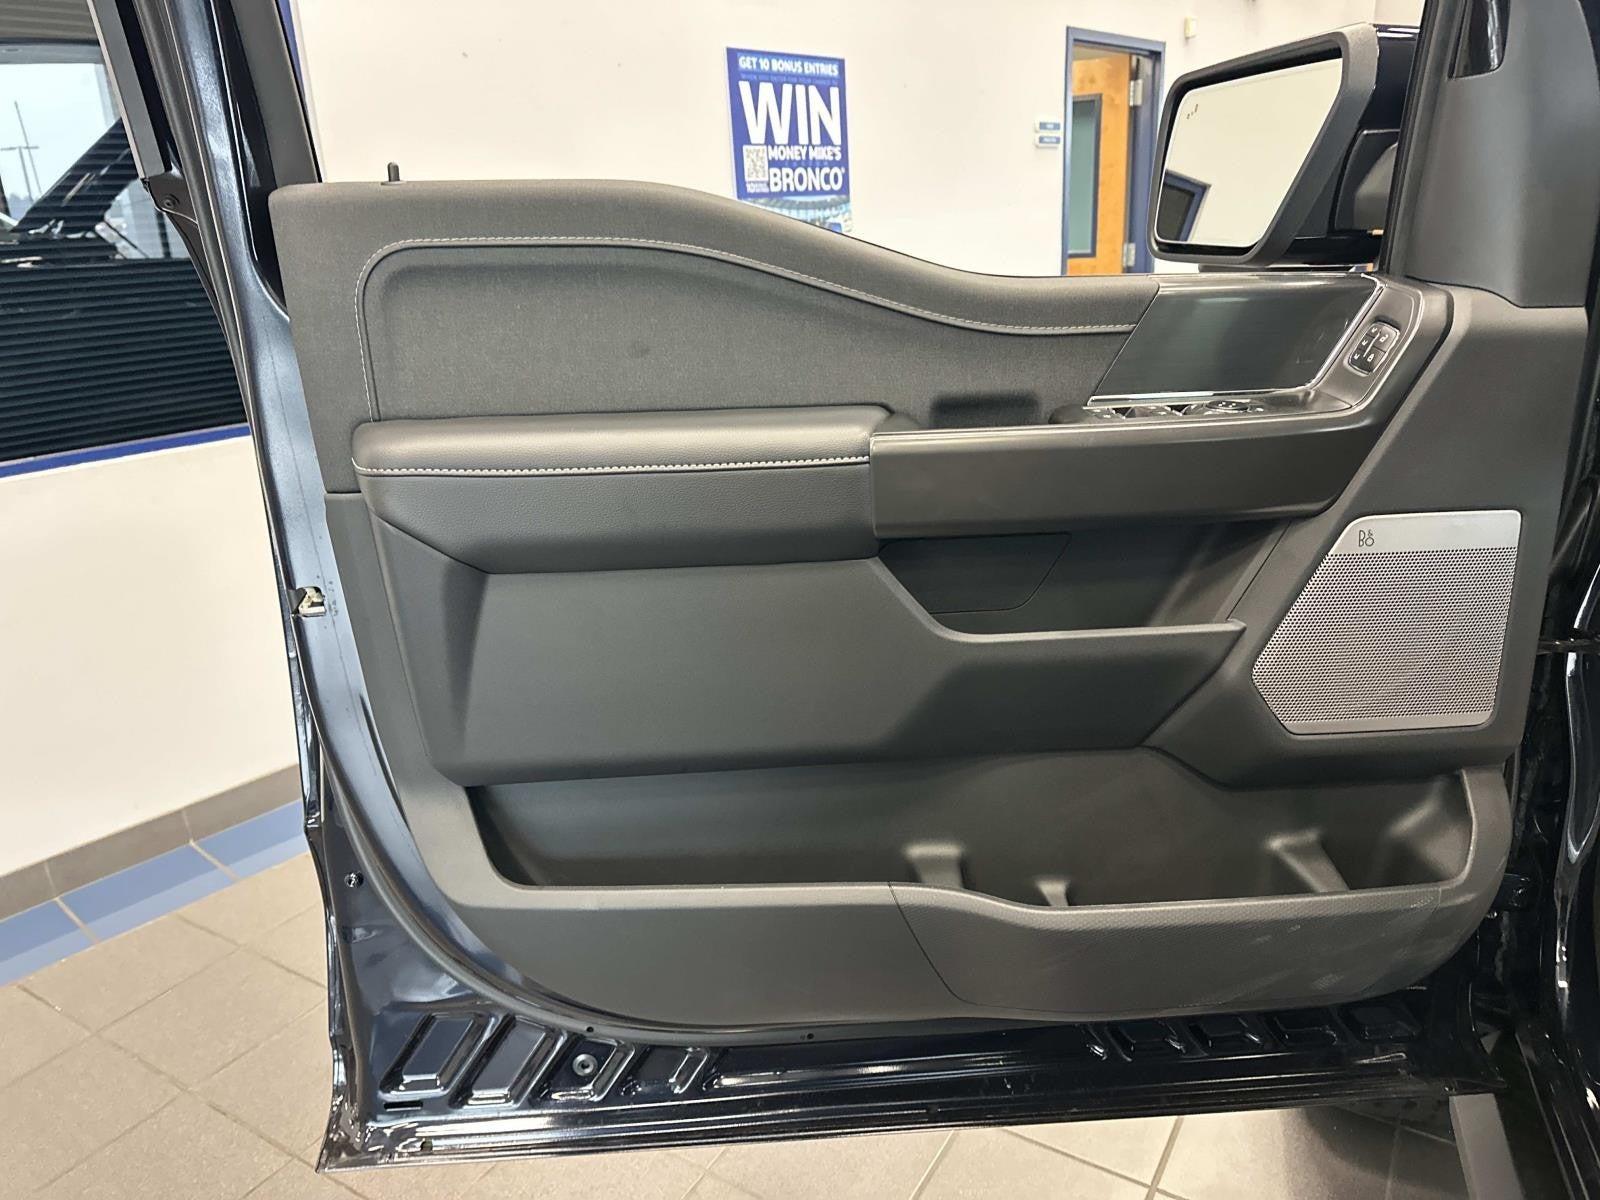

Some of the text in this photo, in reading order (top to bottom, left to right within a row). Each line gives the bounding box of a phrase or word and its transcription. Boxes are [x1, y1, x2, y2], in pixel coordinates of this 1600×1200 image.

[739, 56, 838, 76] GET 10 BONUS ENTRIES
[738, 81, 842, 145] WIN
[768, 145, 807, 160] MONEY
